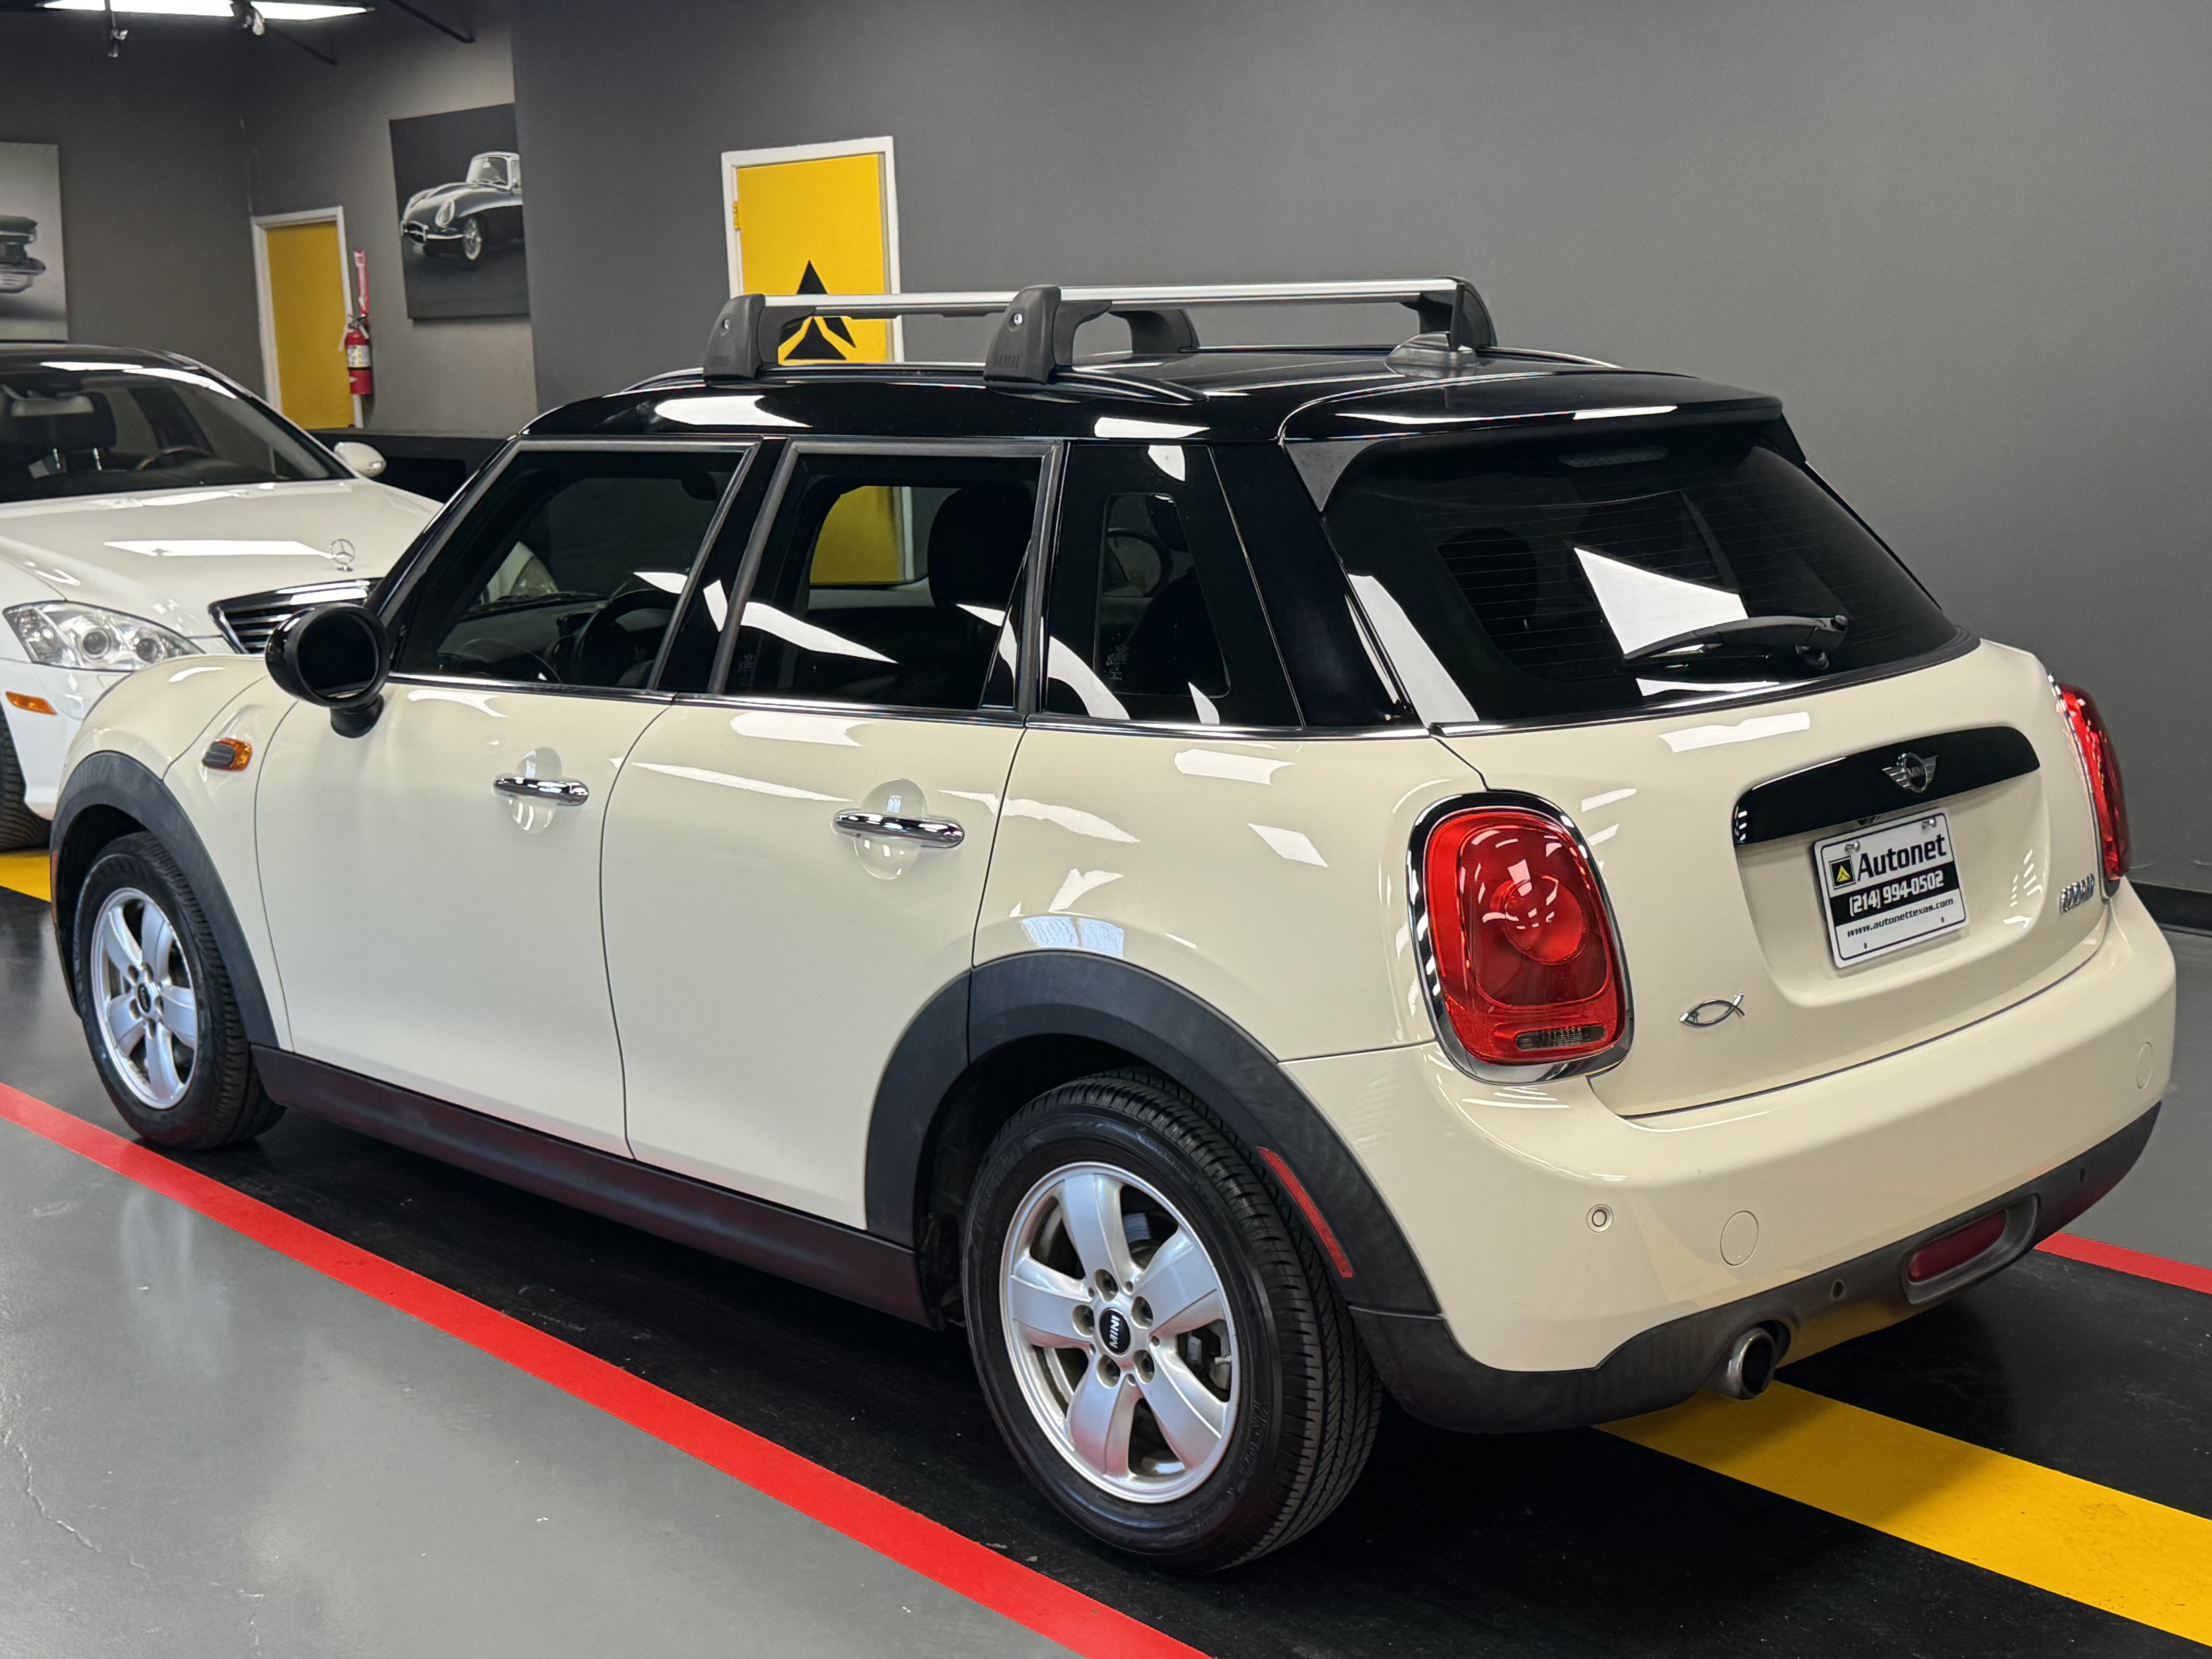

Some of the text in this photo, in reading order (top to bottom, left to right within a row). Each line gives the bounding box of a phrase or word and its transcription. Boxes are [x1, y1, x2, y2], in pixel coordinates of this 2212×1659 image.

[993, 354, 1020, 369] MINI
[1857, 834, 1947, 882] Autonet
[1849, 870, 1945, 917] (214) 994-0502
[1847, 898, 1954, 938] www.autonettexas.com
[1109, 1314, 1120, 1349] MINI
